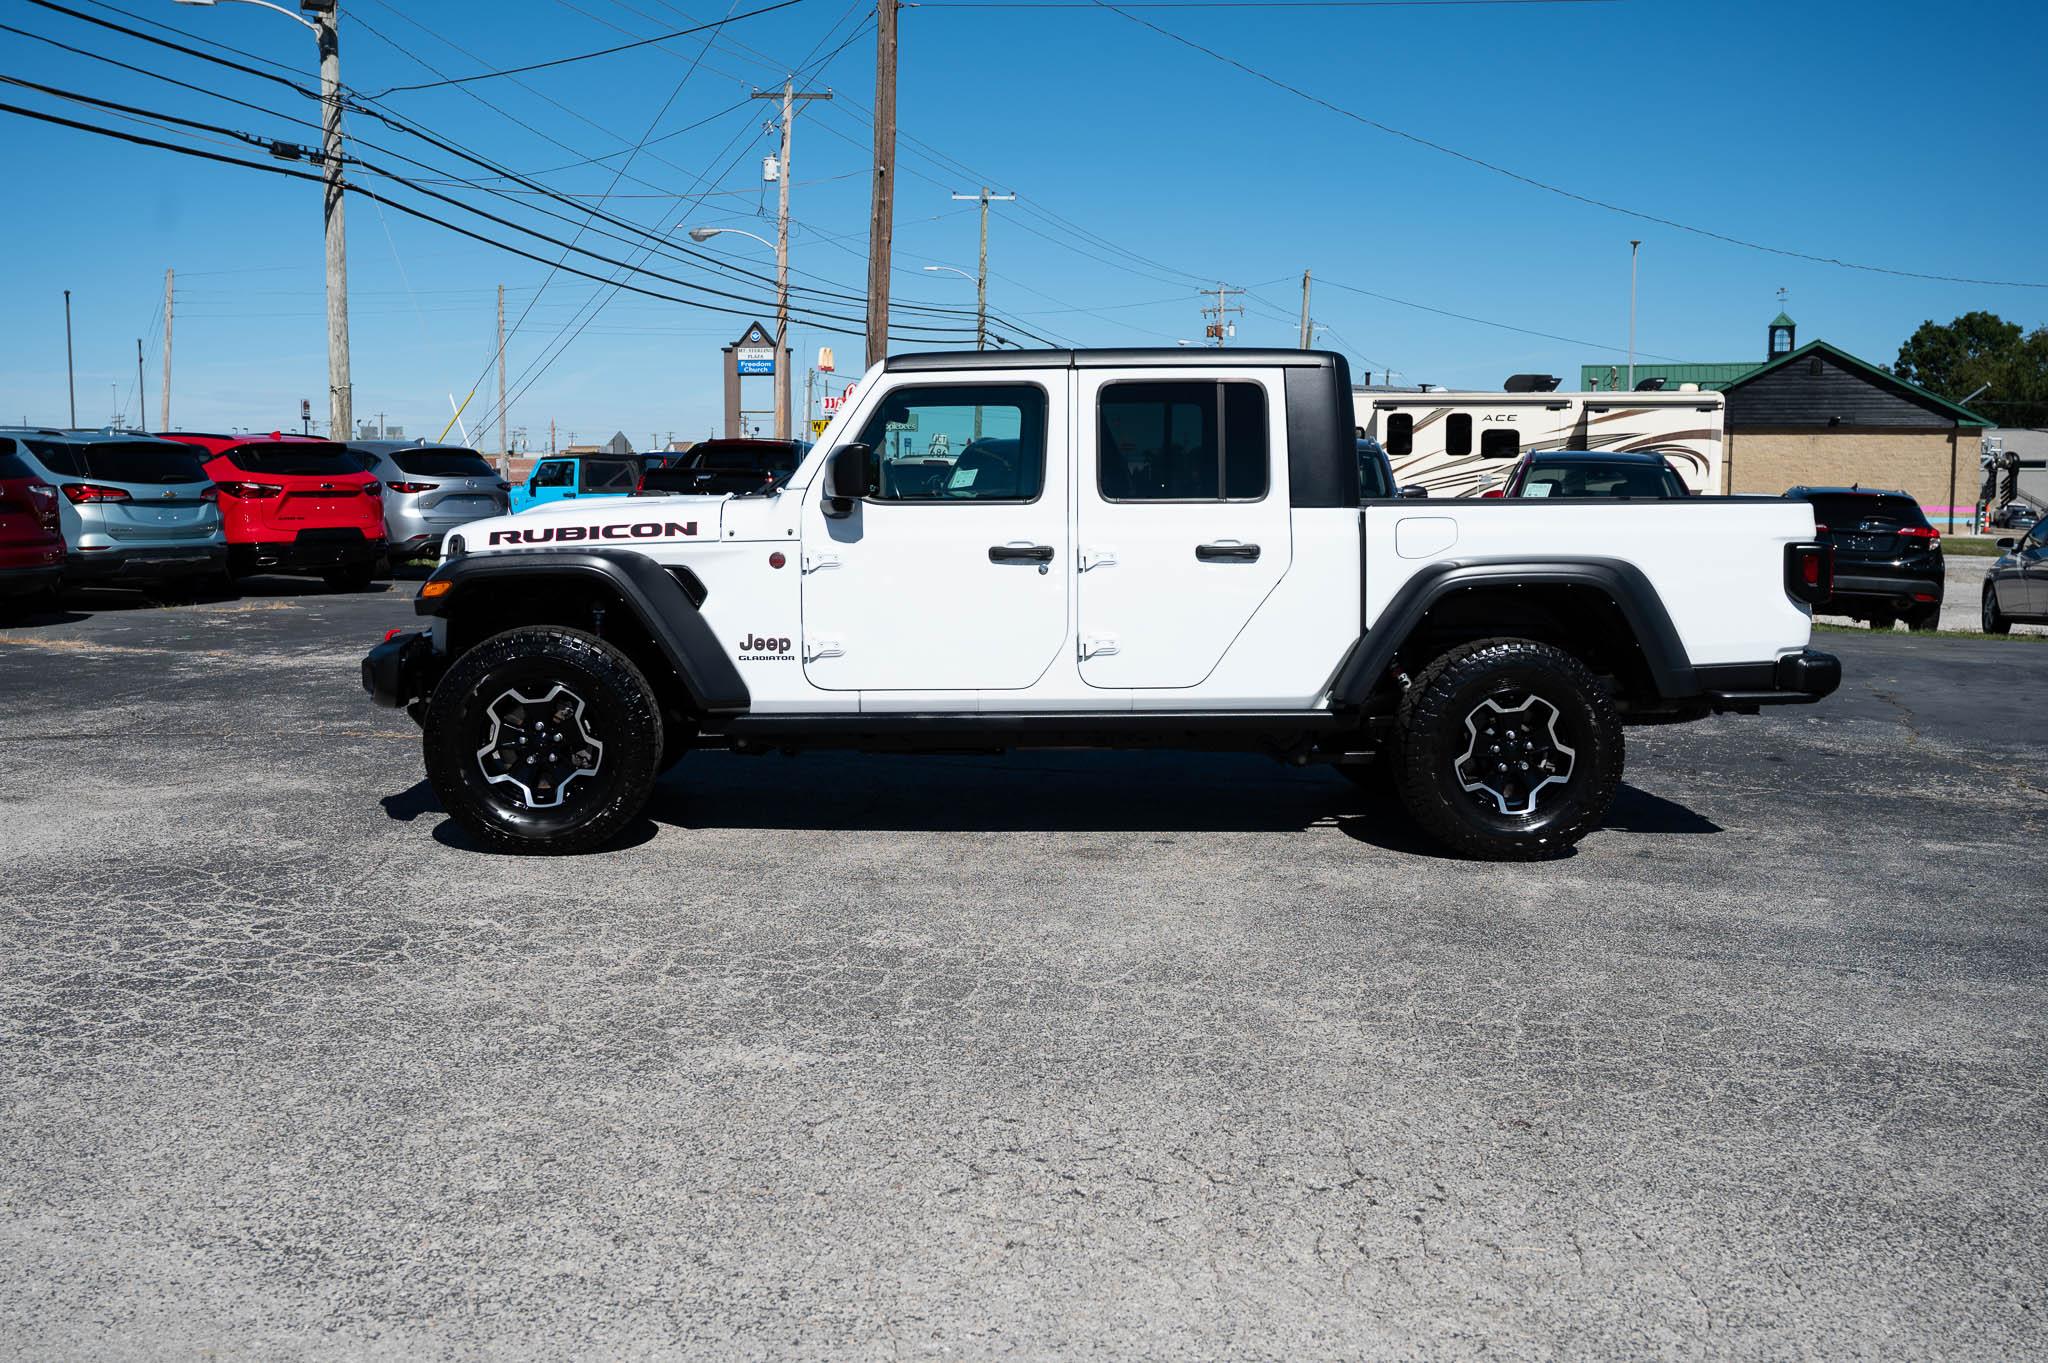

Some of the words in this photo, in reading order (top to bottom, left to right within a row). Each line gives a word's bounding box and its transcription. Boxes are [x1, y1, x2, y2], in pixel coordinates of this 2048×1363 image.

[1482, 414, 1518, 422] ACE
[489, 521, 698, 546] RUBICON
[739, 633, 791, 654] Jeep
